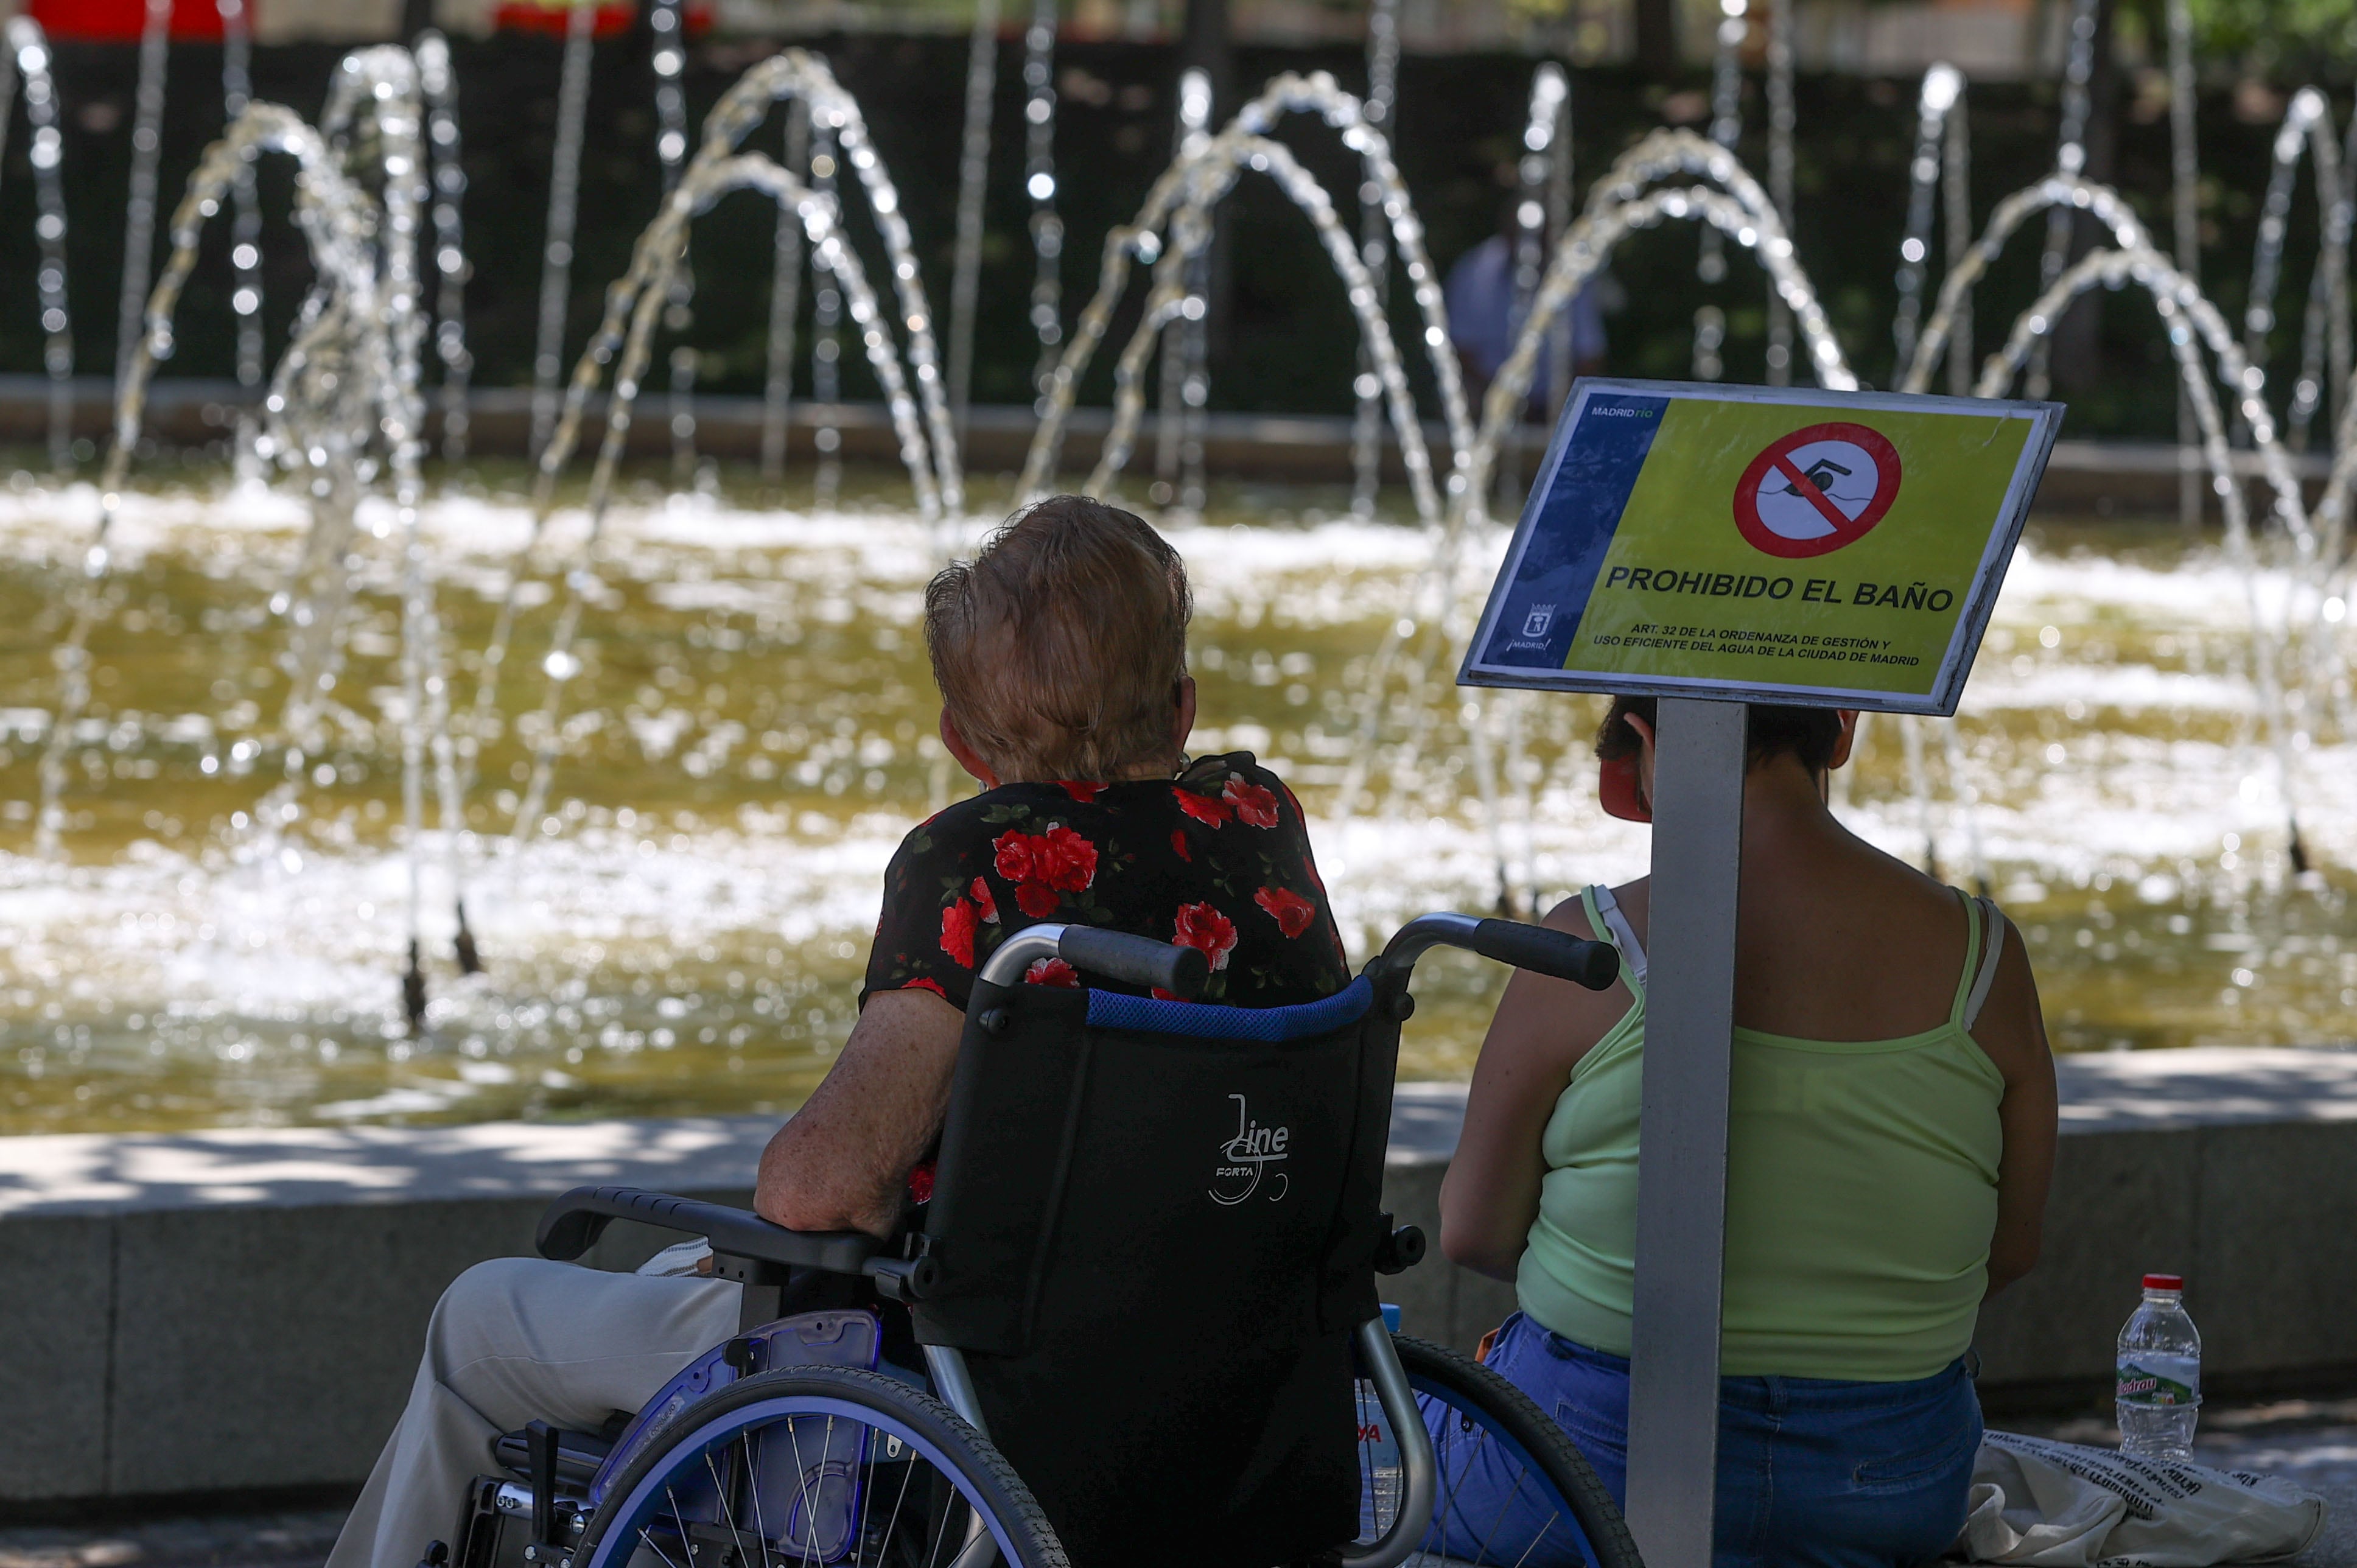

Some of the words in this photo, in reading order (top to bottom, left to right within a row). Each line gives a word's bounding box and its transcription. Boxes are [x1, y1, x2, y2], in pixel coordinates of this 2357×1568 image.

[1605, 566, 1793, 600] PROHIBIDO
[1801, 579, 1842, 604] EL
[1853, 582, 1953, 612] BAÑO
[1594, 635, 1620, 645] USO
[1623, 637, 1687, 650] EFICIENTE
[1690, 641, 1714, 652] DEL
[1717, 643, 1754, 654] AGUA
[1757, 646, 1776, 656] DE
[1778, 648, 1795, 657] LA
[1798, 649, 1847, 661] CIUDAD
[1849, 653, 1868, 663] DE
[1870, 654, 1919, 667] MADRID
[1631, 624, 1658, 634] ART.
[1662, 626, 1676, 635] 32
[1679, 627, 1697, 637] DE
[1699, 629, 1716, 639] LA
[1719, 629, 1798, 644] ORDENANZA
[1801, 635, 1819, 645] DE
[1822, 637, 1879, 650] GESTIÓN
[1883, 640, 1891, 650] Y
[1216, 1167, 1253, 1177] FORTA
